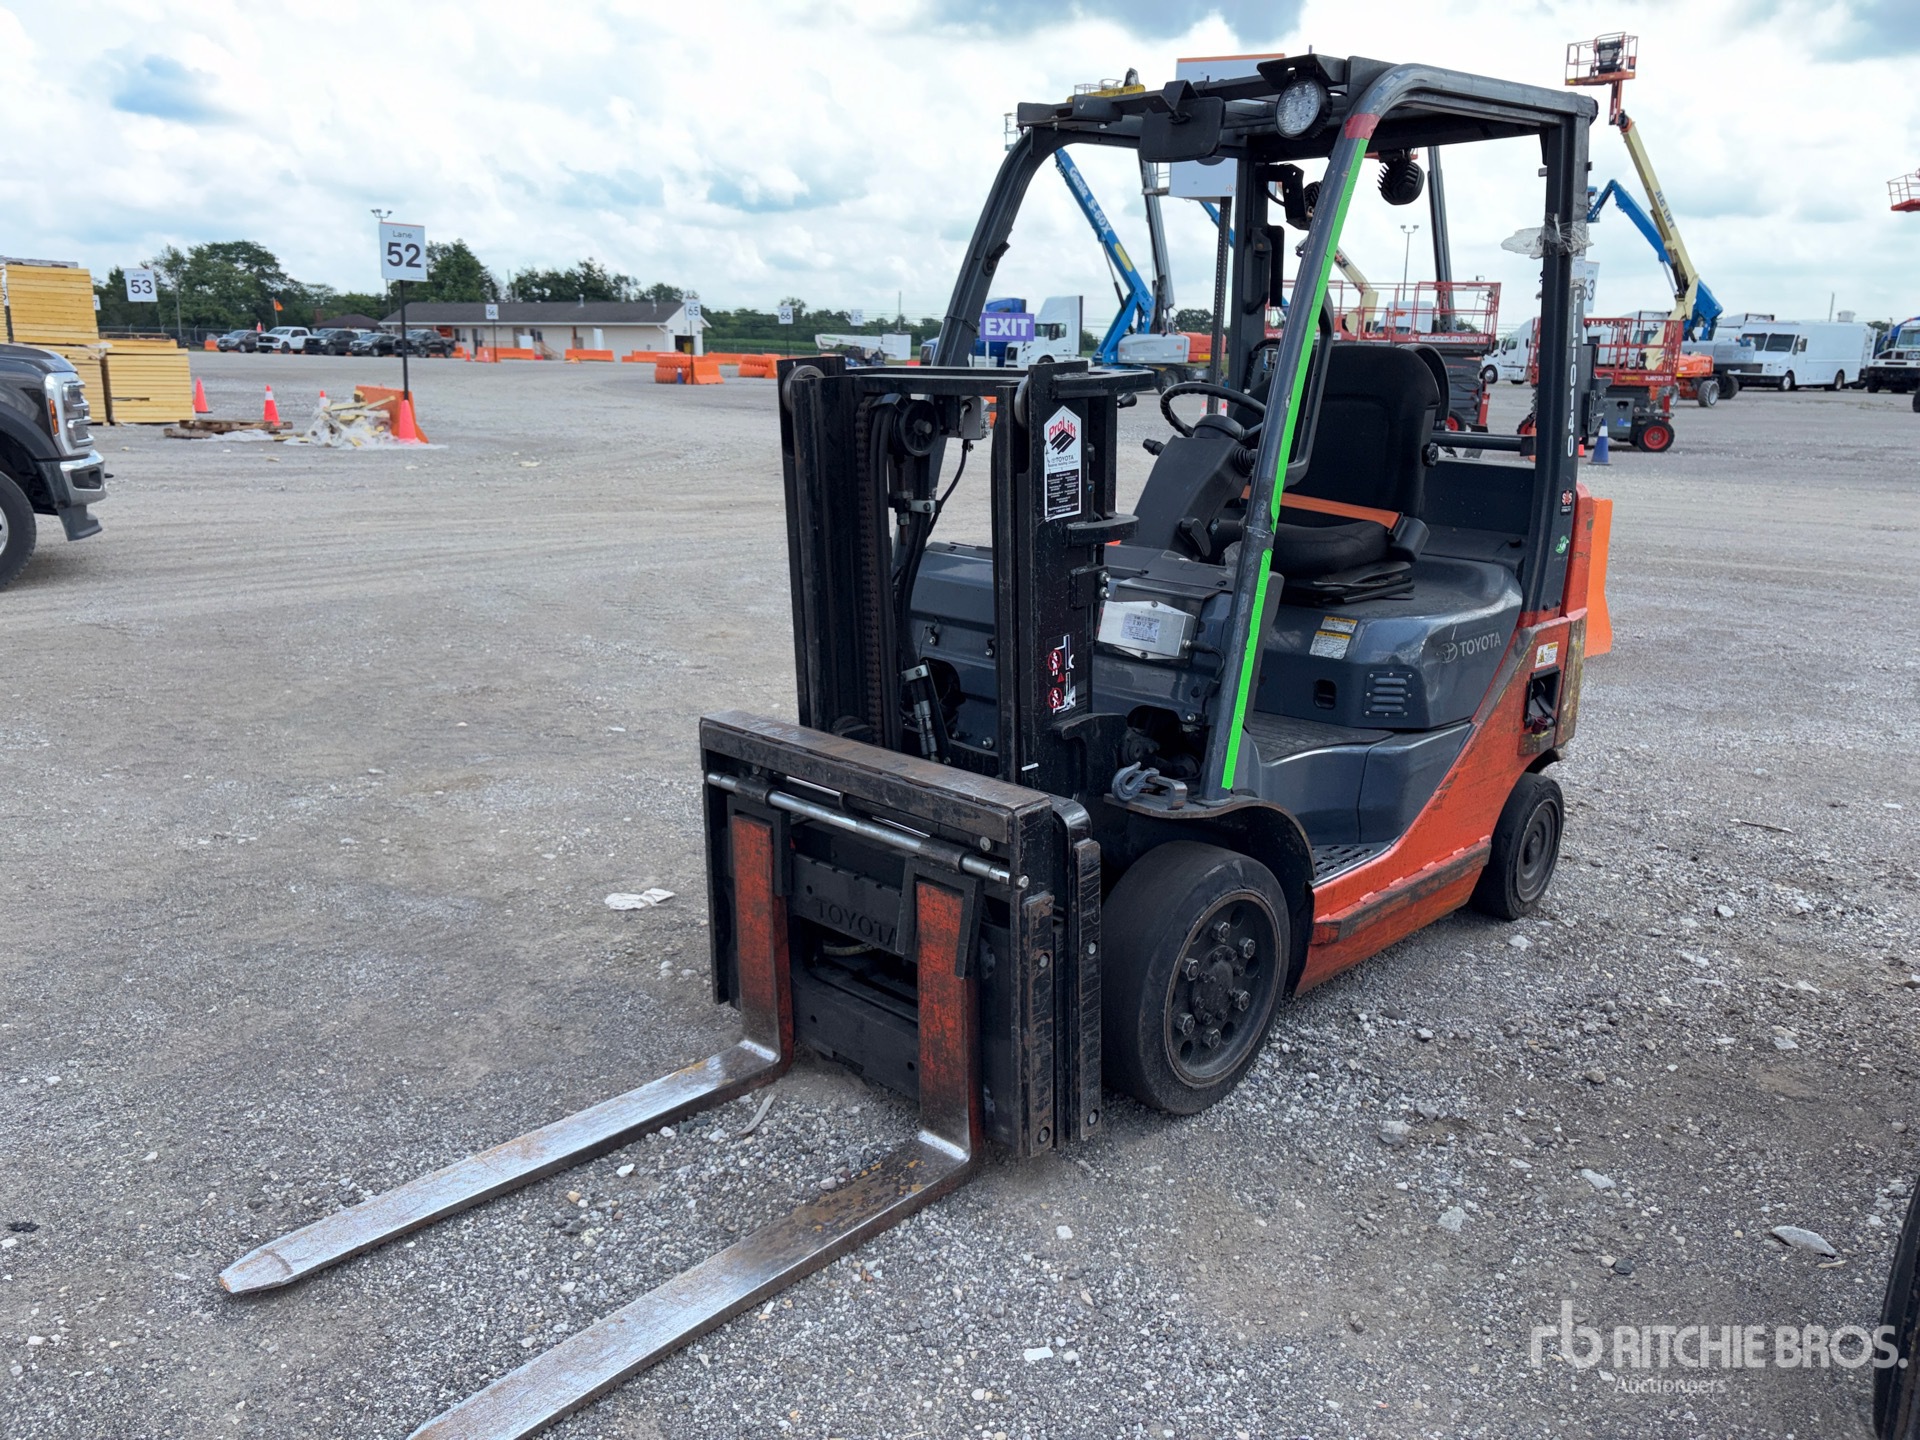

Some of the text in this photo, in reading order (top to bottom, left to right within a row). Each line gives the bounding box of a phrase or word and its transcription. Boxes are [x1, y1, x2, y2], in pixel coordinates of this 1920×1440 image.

[1069, 166, 1112, 235] Genie S-60X
[1655, 190, 1675, 229] JLG LIFT
[392, 230, 413, 239] Lane
[387, 241, 422, 269] 52
[130, 279, 154, 295] 53
[687, 306, 700, 317] 65
[780, 311, 792, 321] 66
[984, 317, 1031, 337] EXIT
[1055, 454, 1074, 463] TOYOTA
[1460, 631, 1502, 657] TOYOTA
